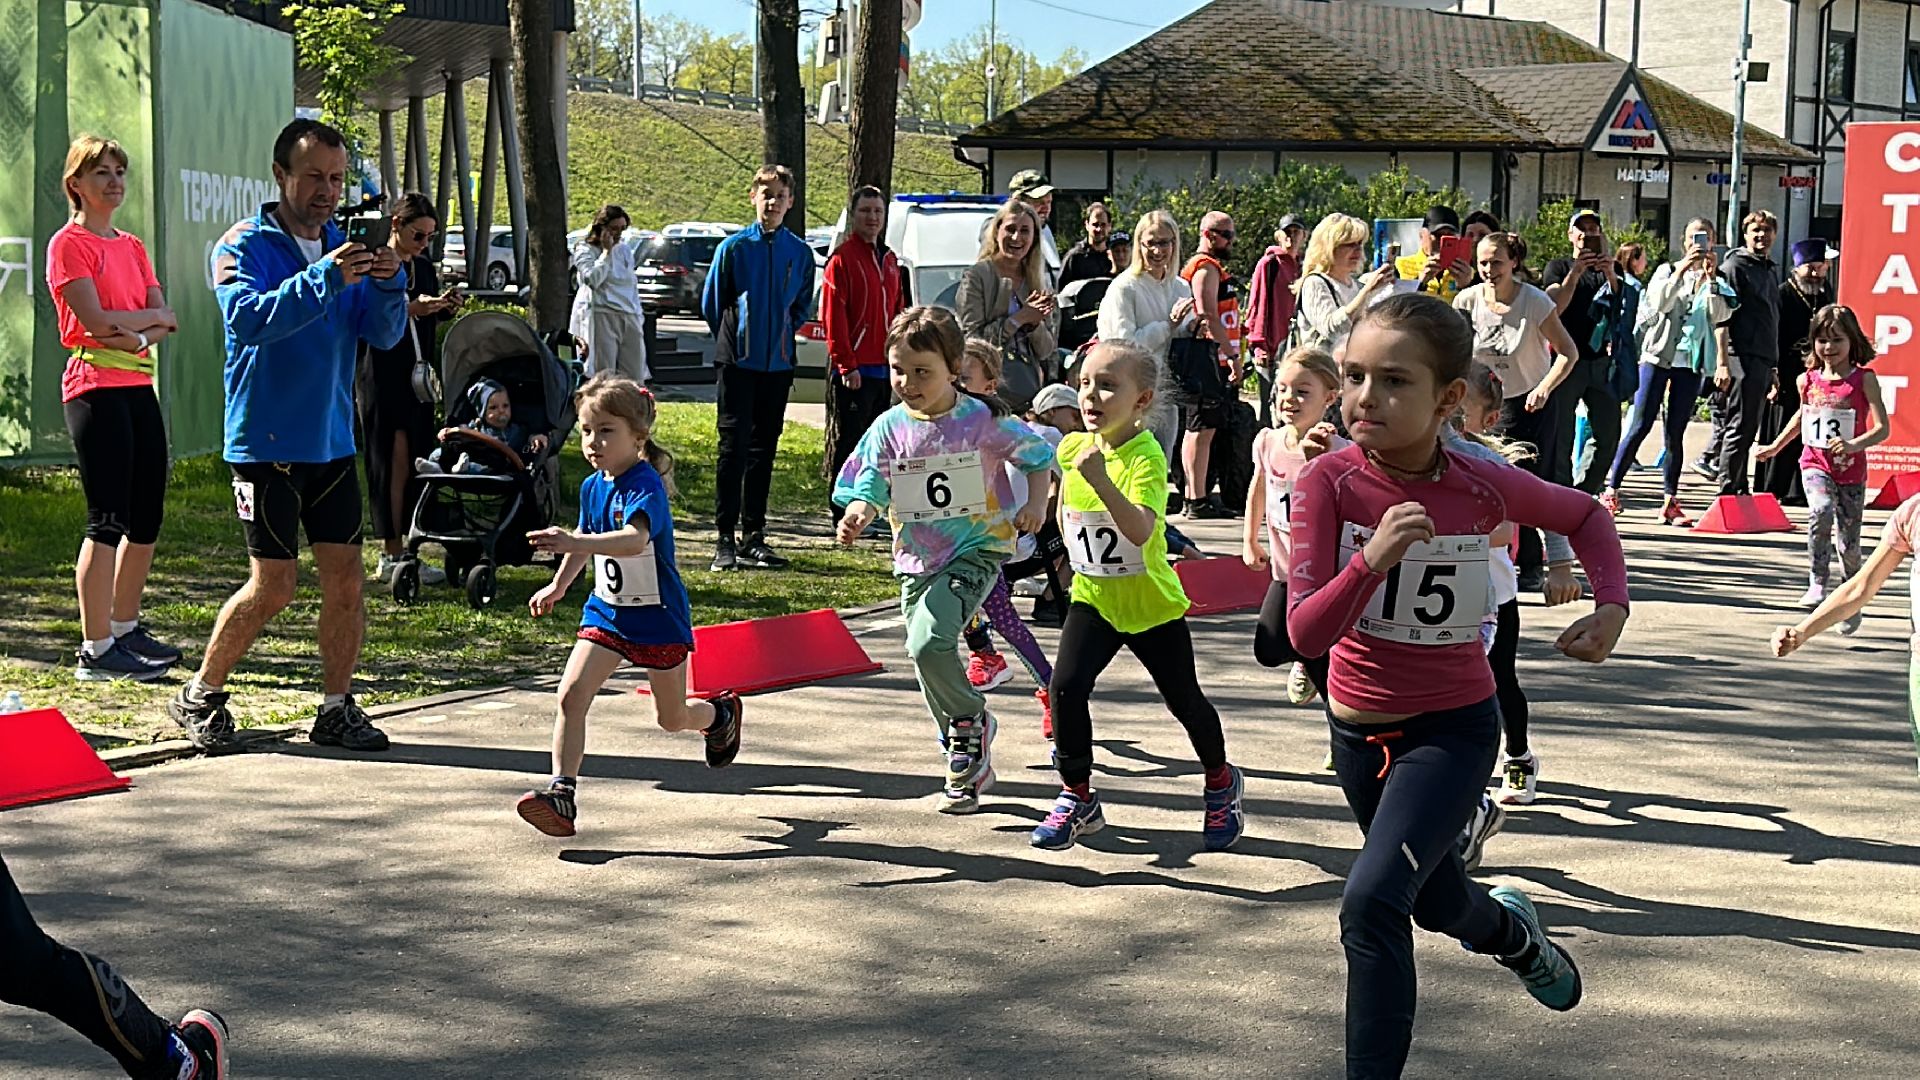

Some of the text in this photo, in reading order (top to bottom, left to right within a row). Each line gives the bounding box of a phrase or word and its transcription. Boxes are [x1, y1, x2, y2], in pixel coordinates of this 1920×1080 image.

[1617, 168, 1670, 183] МАГАЗИН
[1871, 131, 1920, 416] СТАРТ
[1812, 417, 1841, 441] 13
[927, 472, 952, 508] 6
[1077, 526, 1123, 564] 12
[604, 558, 624, 594] 9
[1382, 561, 1457, 625] 15
